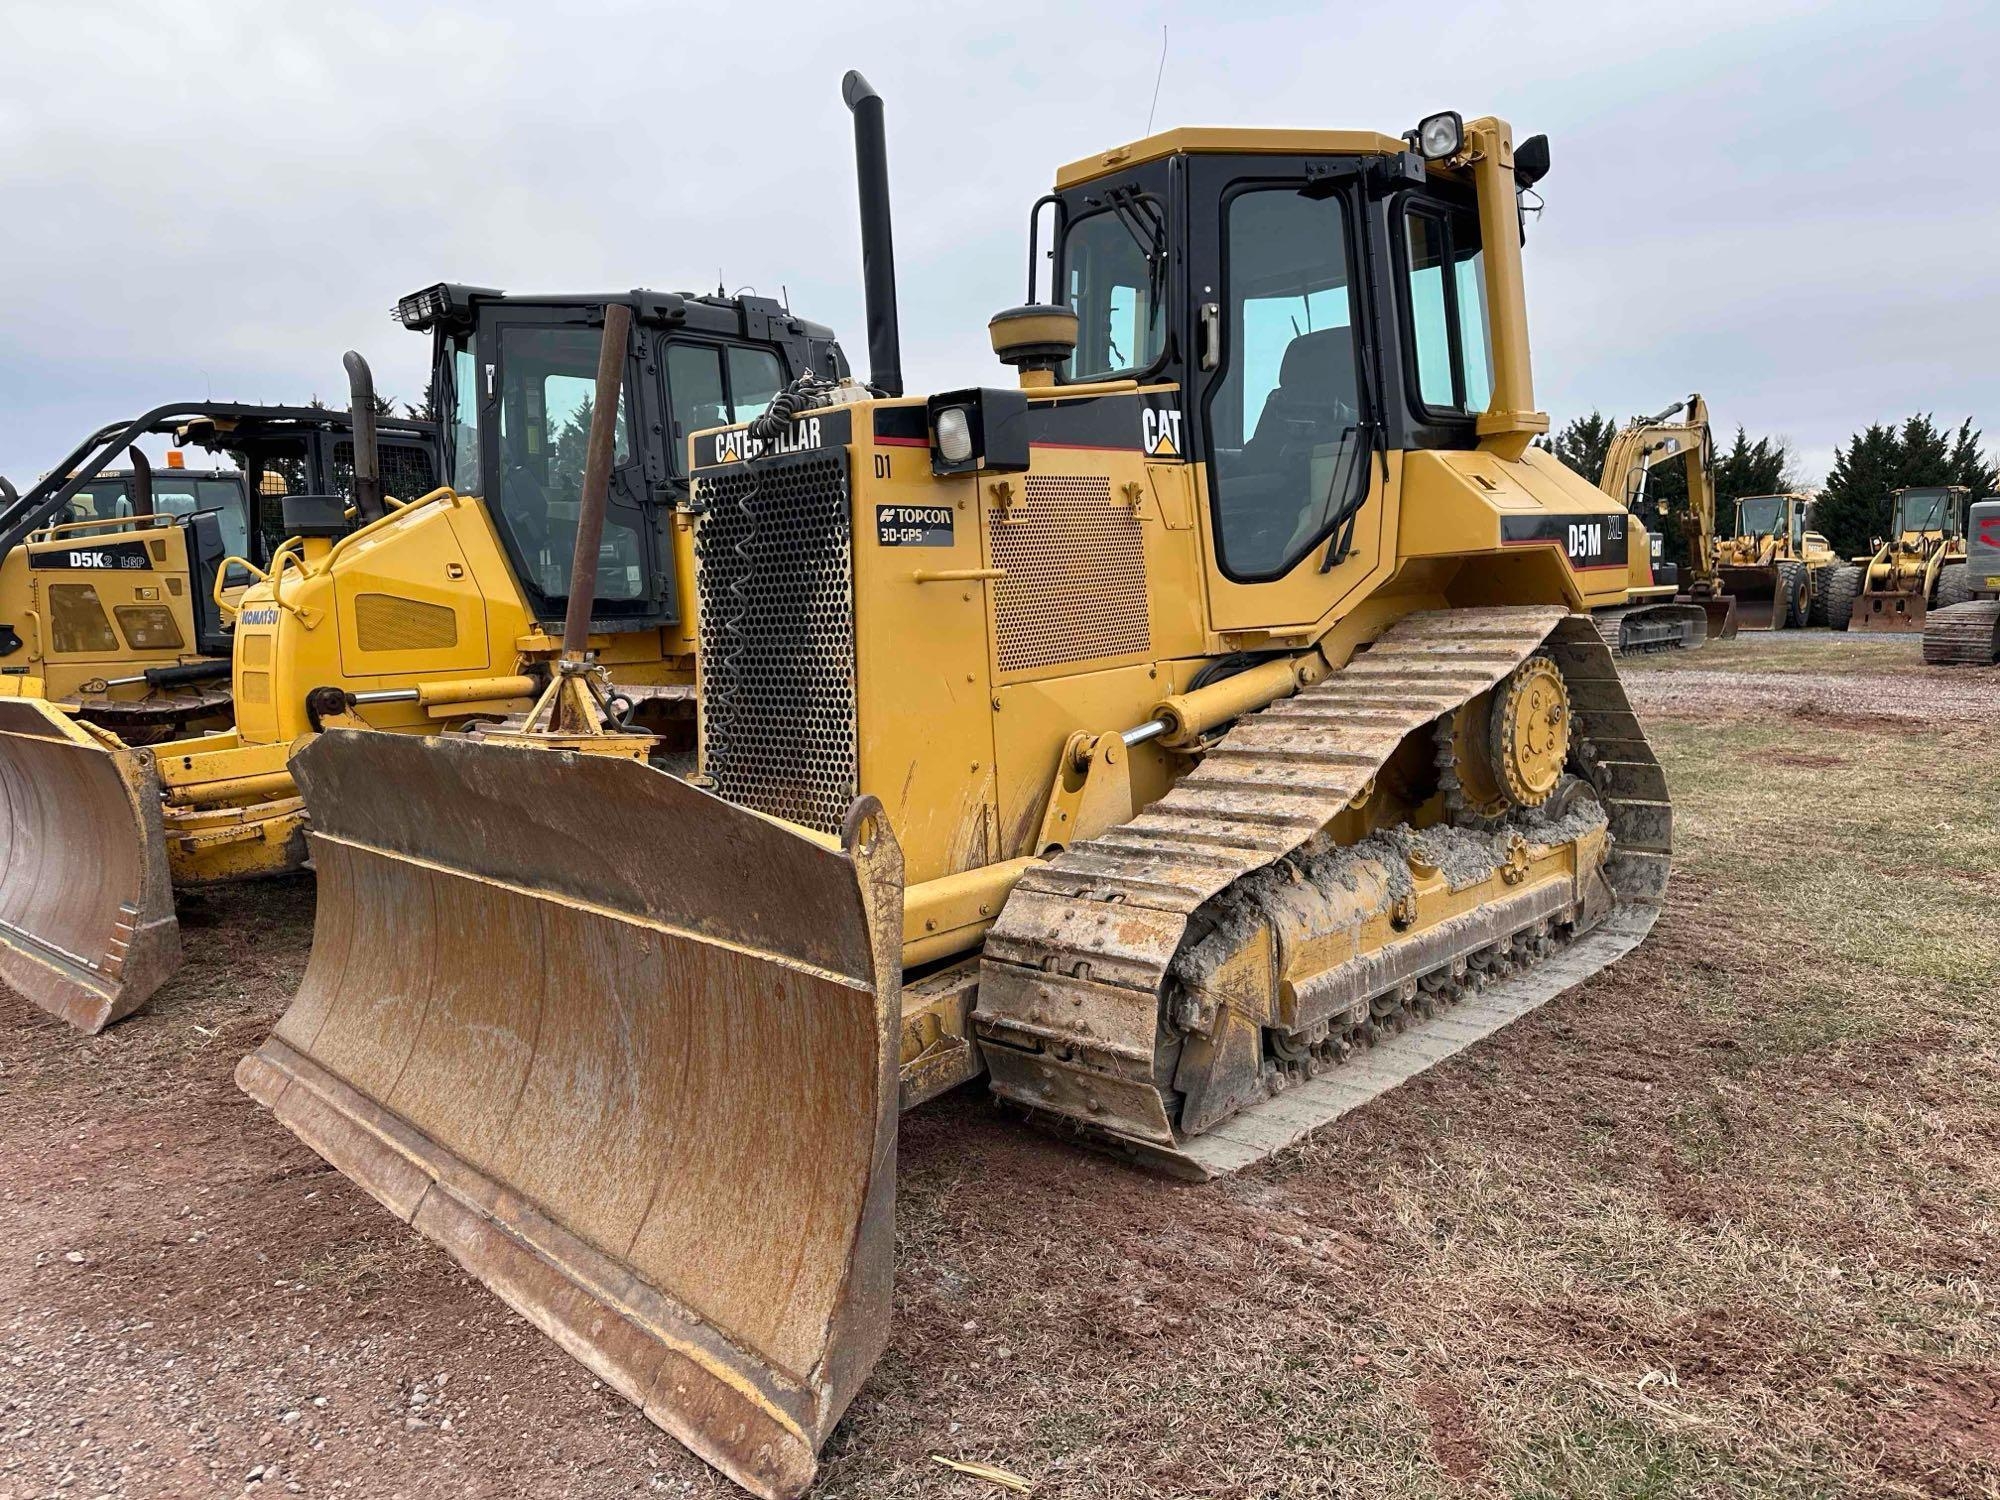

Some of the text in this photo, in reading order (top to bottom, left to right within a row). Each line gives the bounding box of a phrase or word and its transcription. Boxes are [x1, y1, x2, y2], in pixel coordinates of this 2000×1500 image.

[715, 417, 821, 463] CATERILLAR
[1142, 407, 1182, 455] CAT
[874, 454, 891, 479] D1
[896, 508, 951, 524] TOPCON
[881, 528, 923, 542] 3D-GPS
[1568, 515, 1622, 557] D5M XL
[241, 606, 279, 625] KOMATSU
